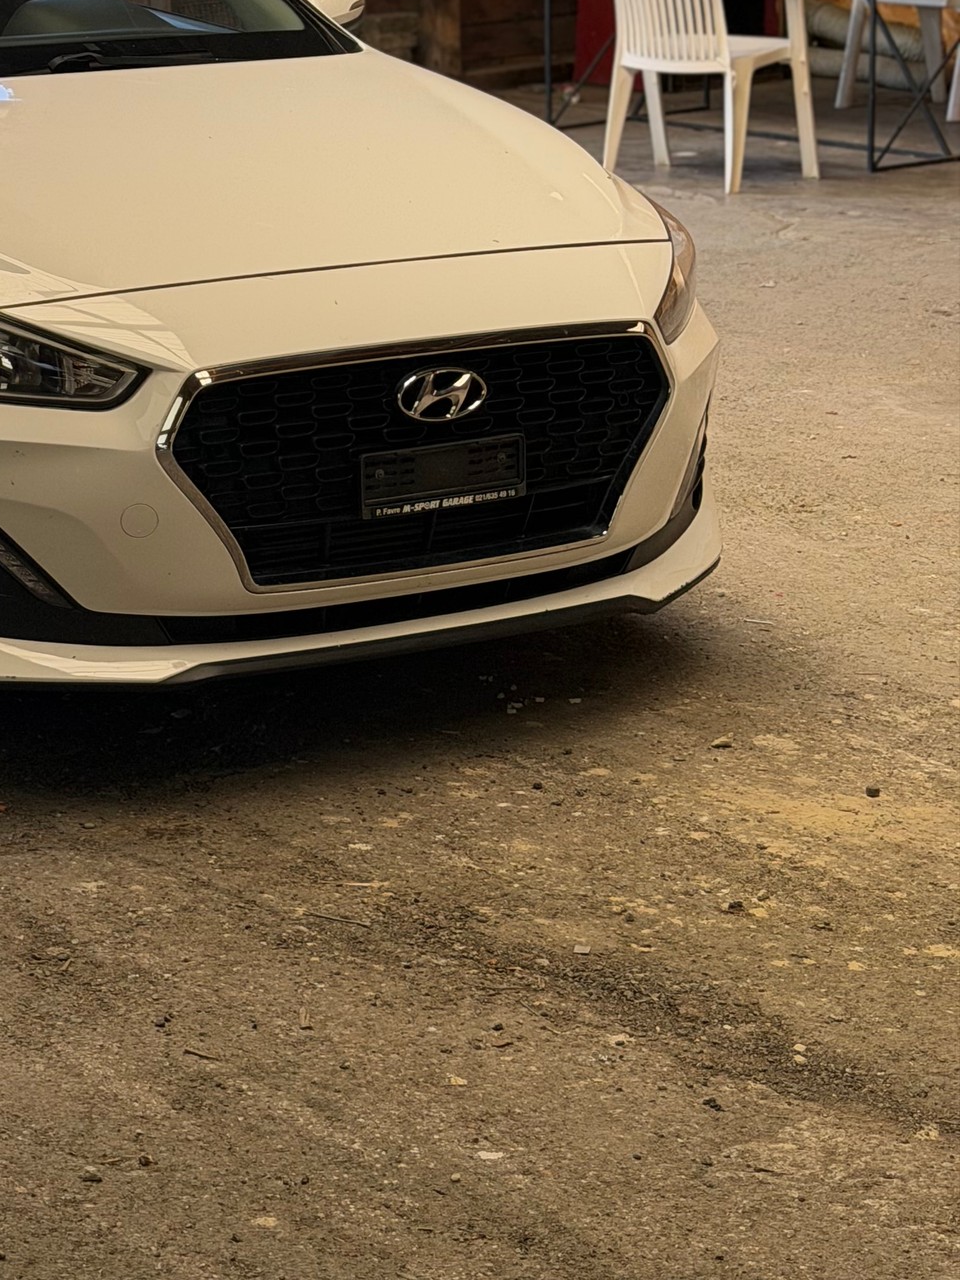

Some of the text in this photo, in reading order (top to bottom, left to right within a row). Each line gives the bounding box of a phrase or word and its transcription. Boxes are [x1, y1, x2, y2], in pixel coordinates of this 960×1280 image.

[383, 507, 401, 516] Favre
[402, 500, 440, 513] M-SPORT
[442, 495, 474, 507] GARAGE
